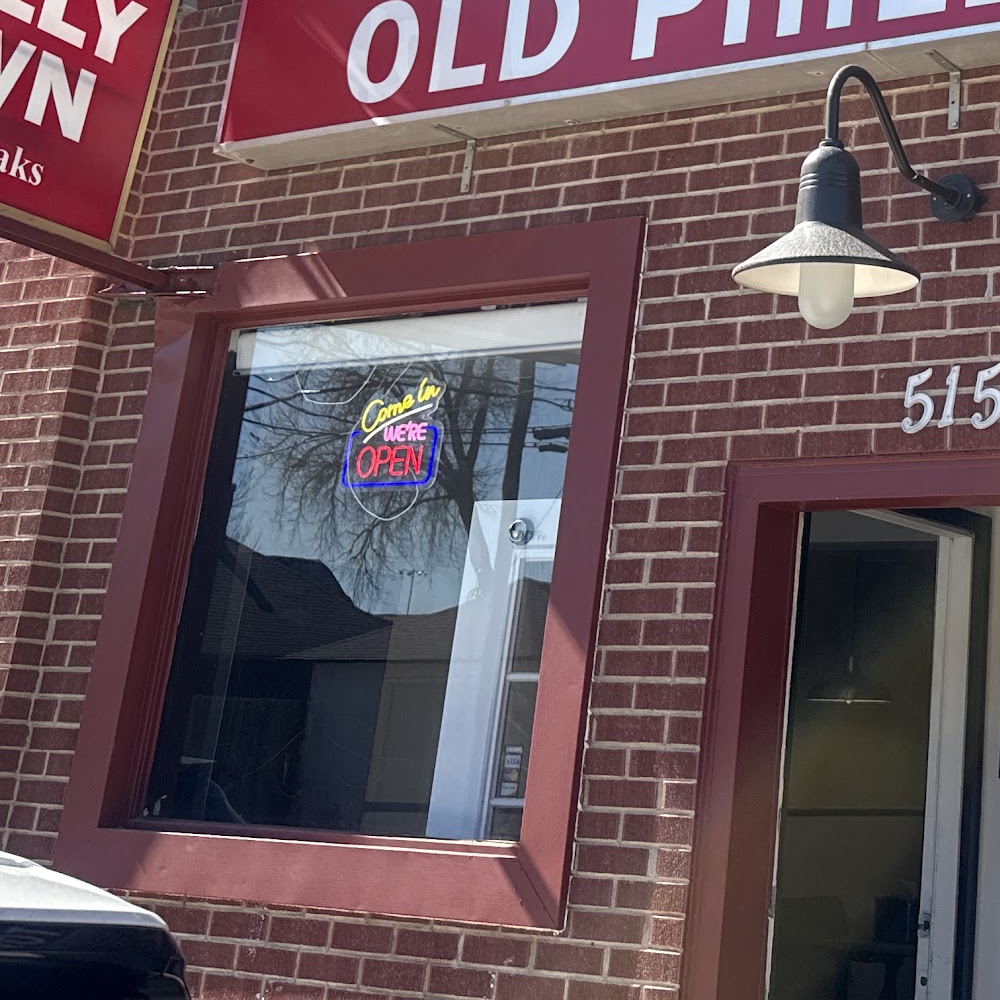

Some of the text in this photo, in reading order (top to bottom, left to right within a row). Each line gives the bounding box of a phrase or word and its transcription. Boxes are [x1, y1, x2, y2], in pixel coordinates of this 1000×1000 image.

[361, 394, 415, 433] Come
[383, 420, 428, 442] WE'RE
[356, 444, 424, 478] OPEN
